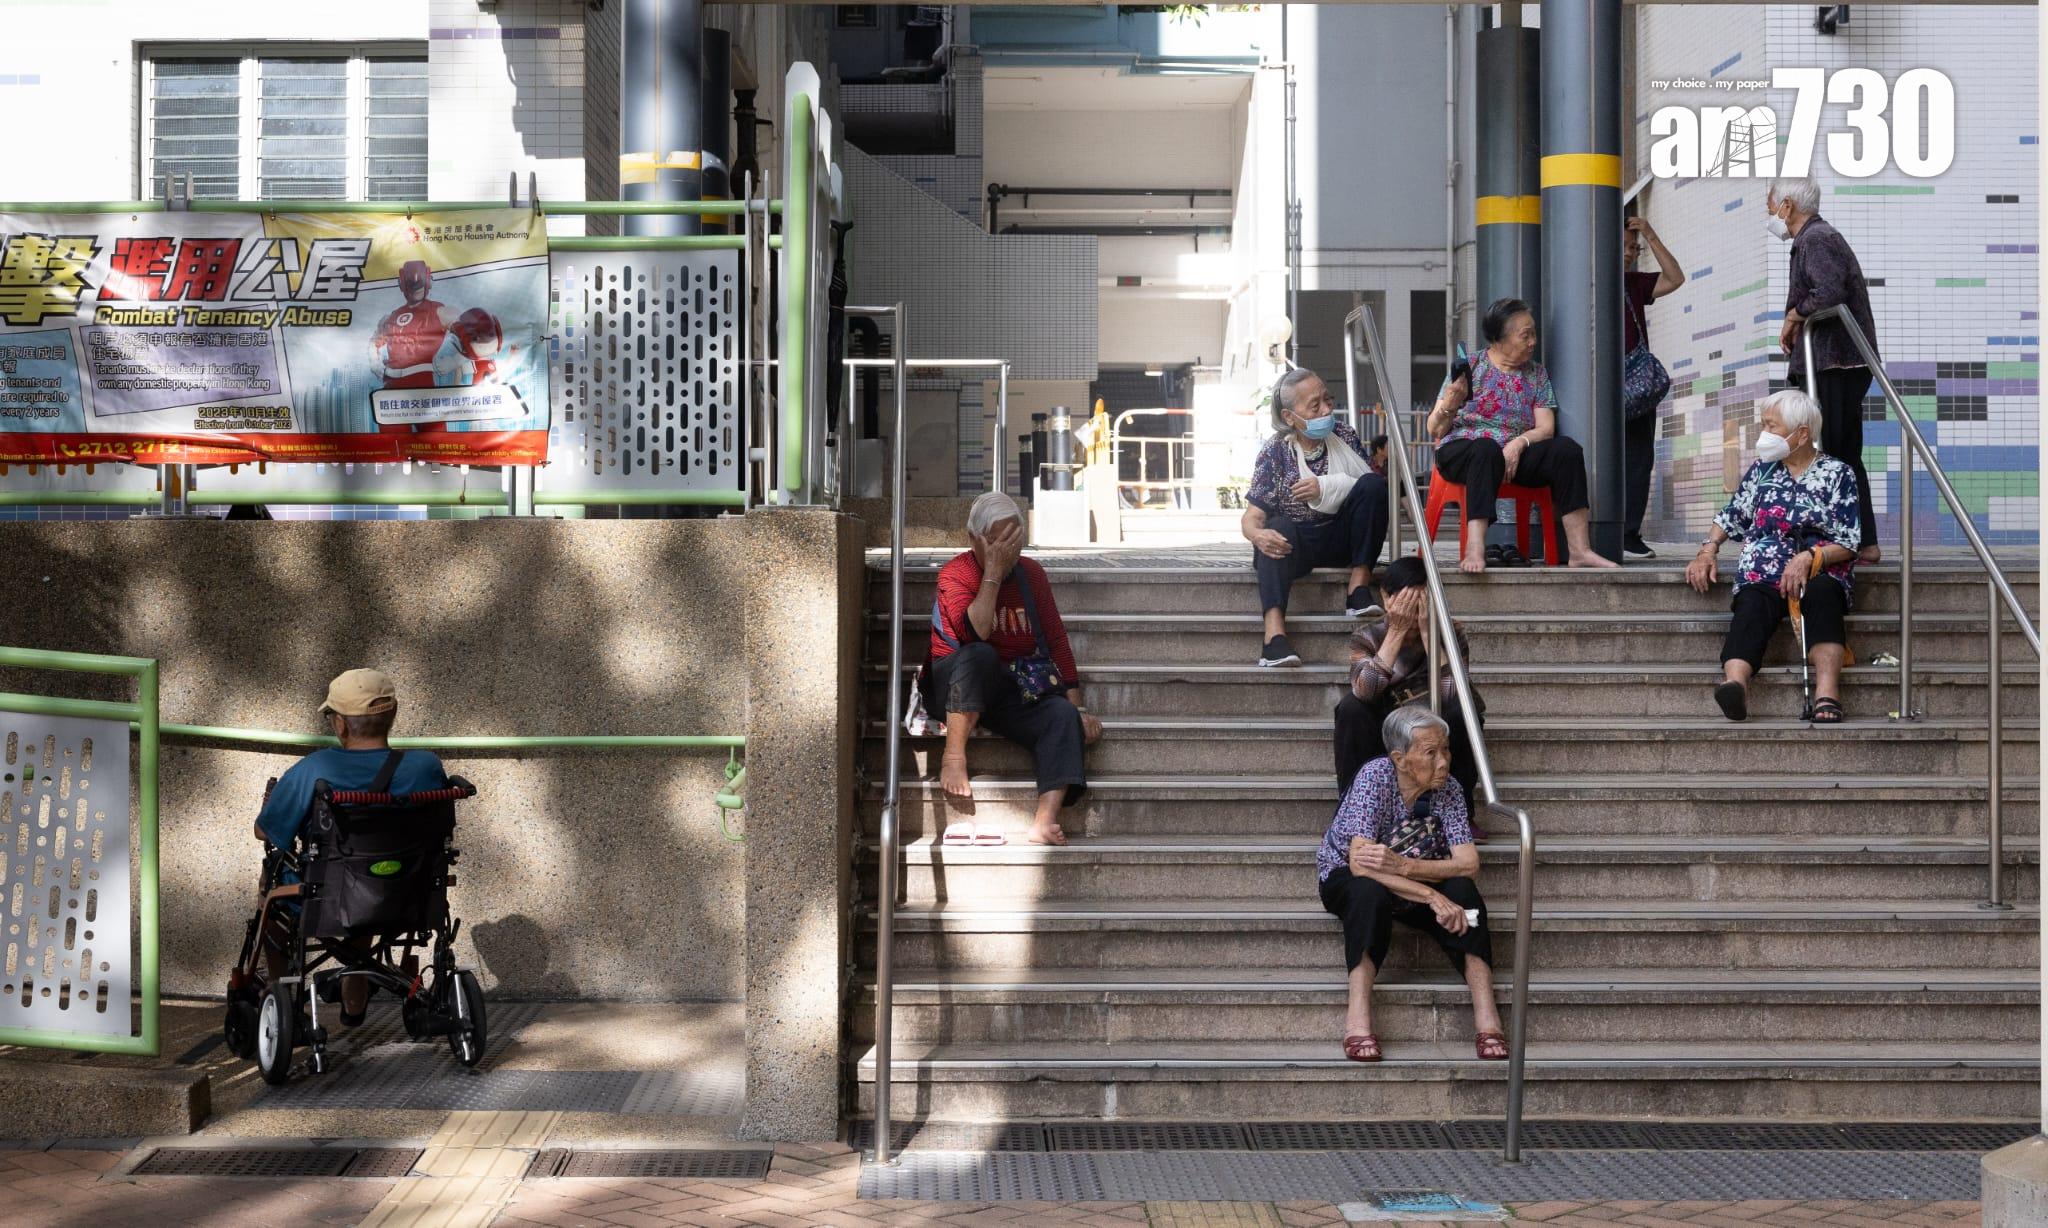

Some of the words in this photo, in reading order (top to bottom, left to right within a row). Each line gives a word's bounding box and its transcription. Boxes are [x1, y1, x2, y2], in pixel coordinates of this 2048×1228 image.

[423, 235, 442, 243] Hong
[444, 233, 463, 242] Kong
[464, 231, 494, 241] Housing
[496, 231, 530, 240] Authority
[95, 306, 177, 327] Combat
[181, 306, 280, 330] Tenancy
[279, 305, 352, 327] Abuse
[94, 363, 126, 374] Tenants
[128, 365, 150, 374] must
[152, 364, 176, 374] make
[177, 363, 231, 374] declarations
[232, 363, 240, 374] if
[240, 363, 259, 376] they
[7, 377, 40, 387] tenants
[42, 377, 61, 387] and
[98, 380, 115, 389] own
[117, 380, 132, 391] any
[134, 378, 172, 389] domestic
[173, 380, 209, 391] property
[210, 378, 220, 388] in
[222, 378, 245, 391] Hong
[246, 378, 270, 391] Kong
[1, 392, 17, 402] are
[18, 391, 58, 404] required
[59, 391, 69, 402] to
[1, 407, 25, 419] every
[26, 405, 33, 417] 2
[34, 407, 59, 418] years
[194, 420, 226, 430] Effective
[226, 420, 244, 430] from
[245, 420, 272, 430] October
[273, 420, 292, 430] 2023
[79, 442, 128, 455] 2712
[132, 440, 180, 454] 2712
